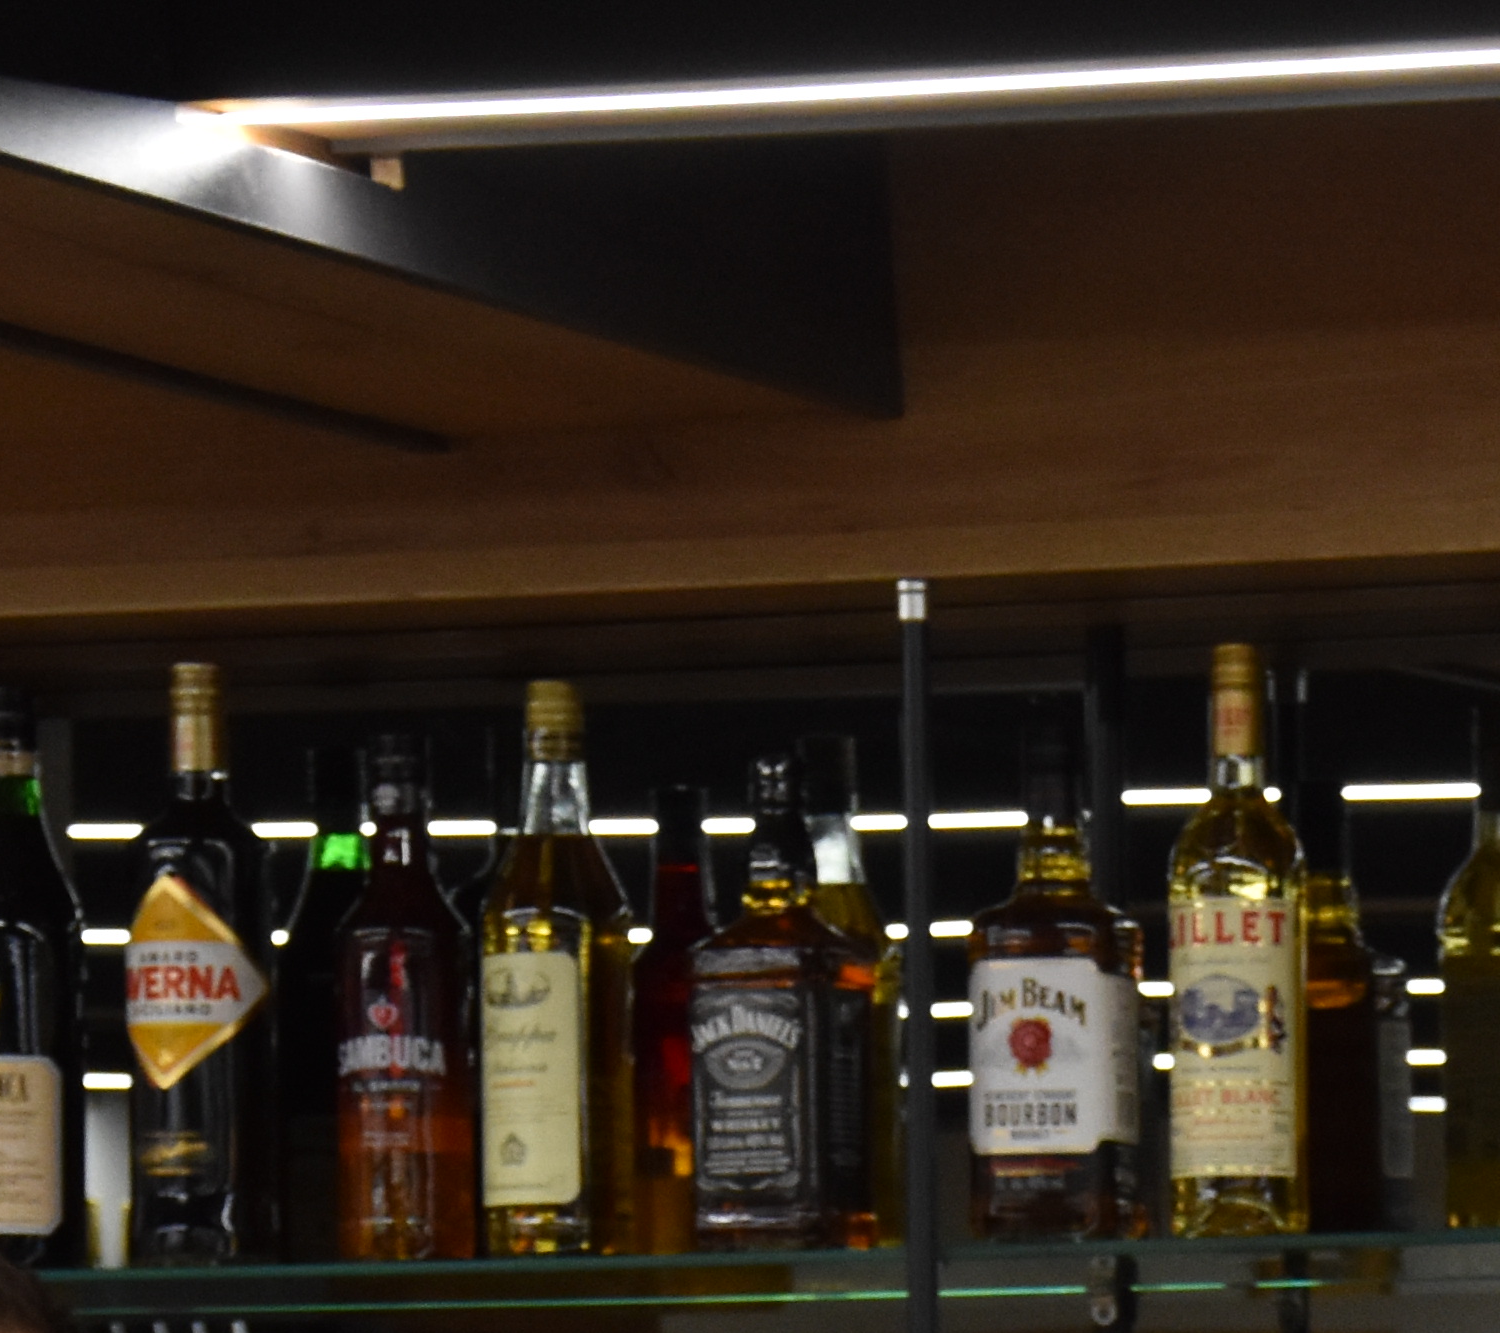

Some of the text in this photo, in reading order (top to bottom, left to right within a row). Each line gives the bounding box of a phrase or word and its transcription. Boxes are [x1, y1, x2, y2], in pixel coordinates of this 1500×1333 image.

[976, 976, 1087, 1031] JIM BEAM
[983, 1102, 1078, 1128] BOURBON
